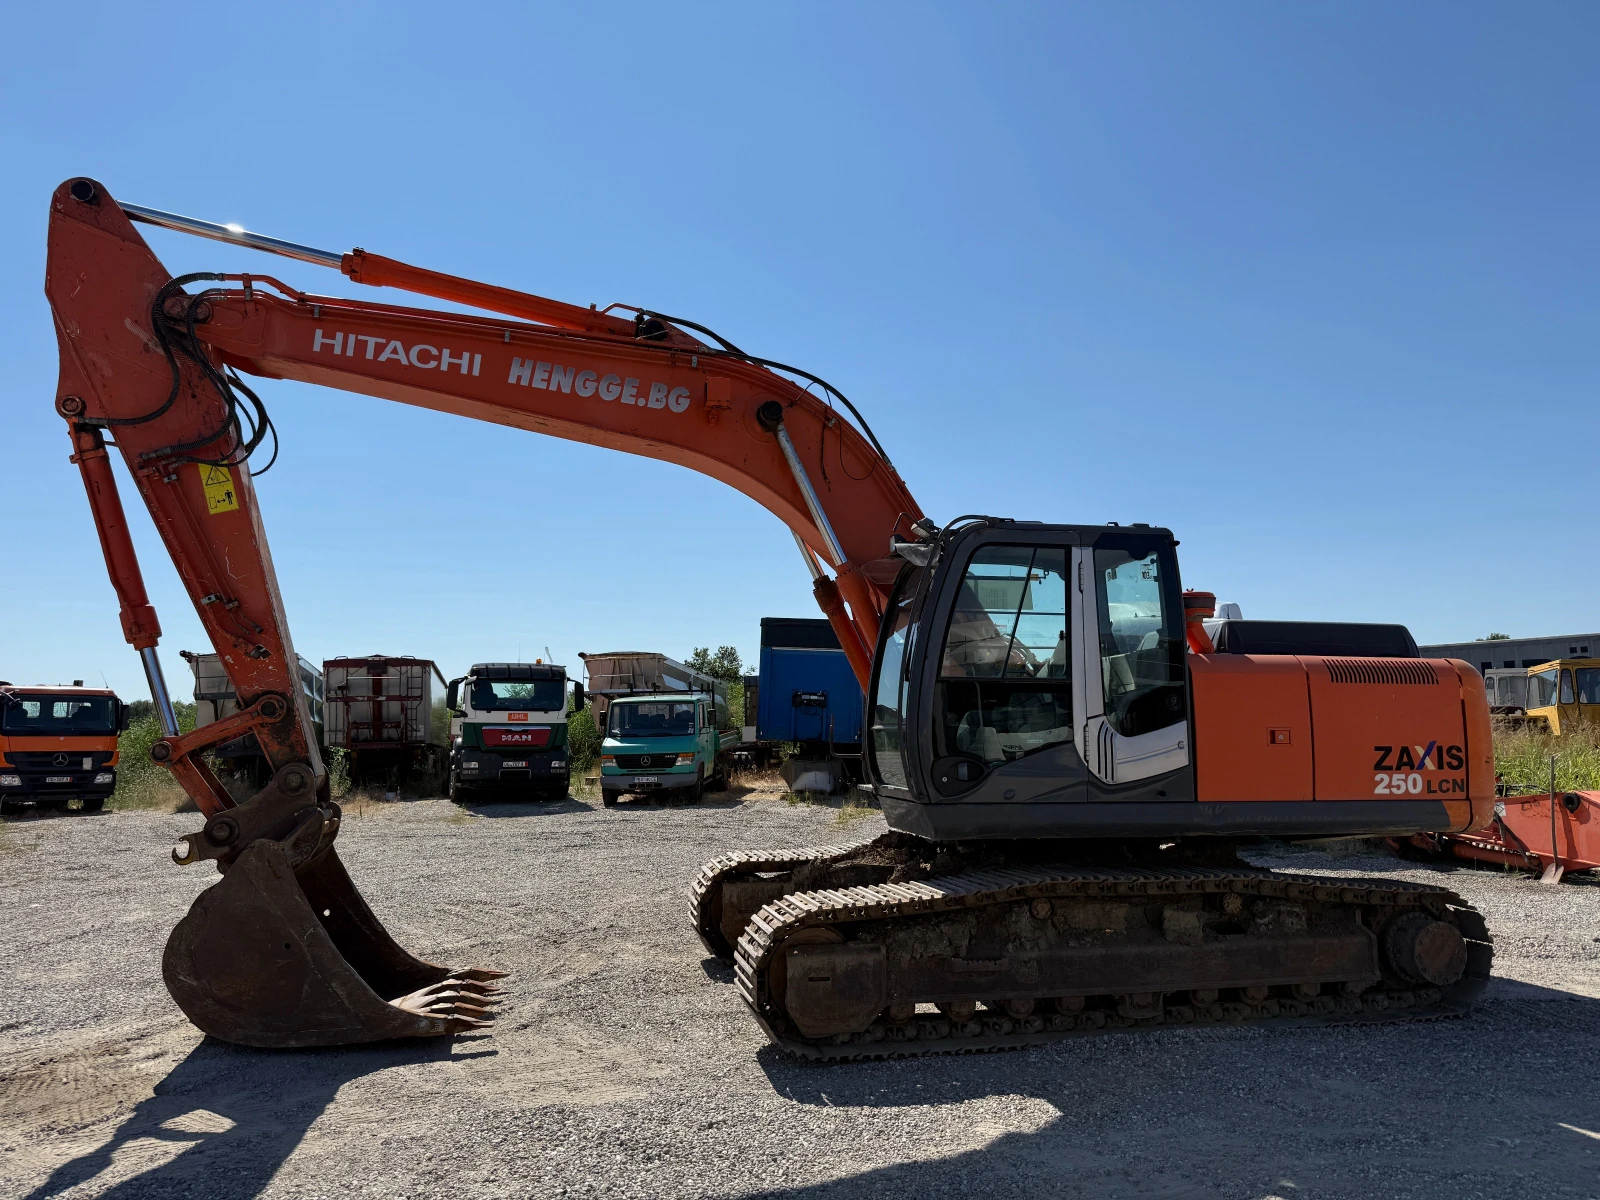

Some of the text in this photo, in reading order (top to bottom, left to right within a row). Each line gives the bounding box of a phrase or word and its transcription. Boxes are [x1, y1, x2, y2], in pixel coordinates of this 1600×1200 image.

[313, 328, 481, 377] HITACHI
[507, 356, 691, 413] HENGGE.BG
[501, 734, 532, 742] MAN
[1373, 740, 1464, 771] ZAXIS
[1373, 773, 1465, 795] 250 LCN
